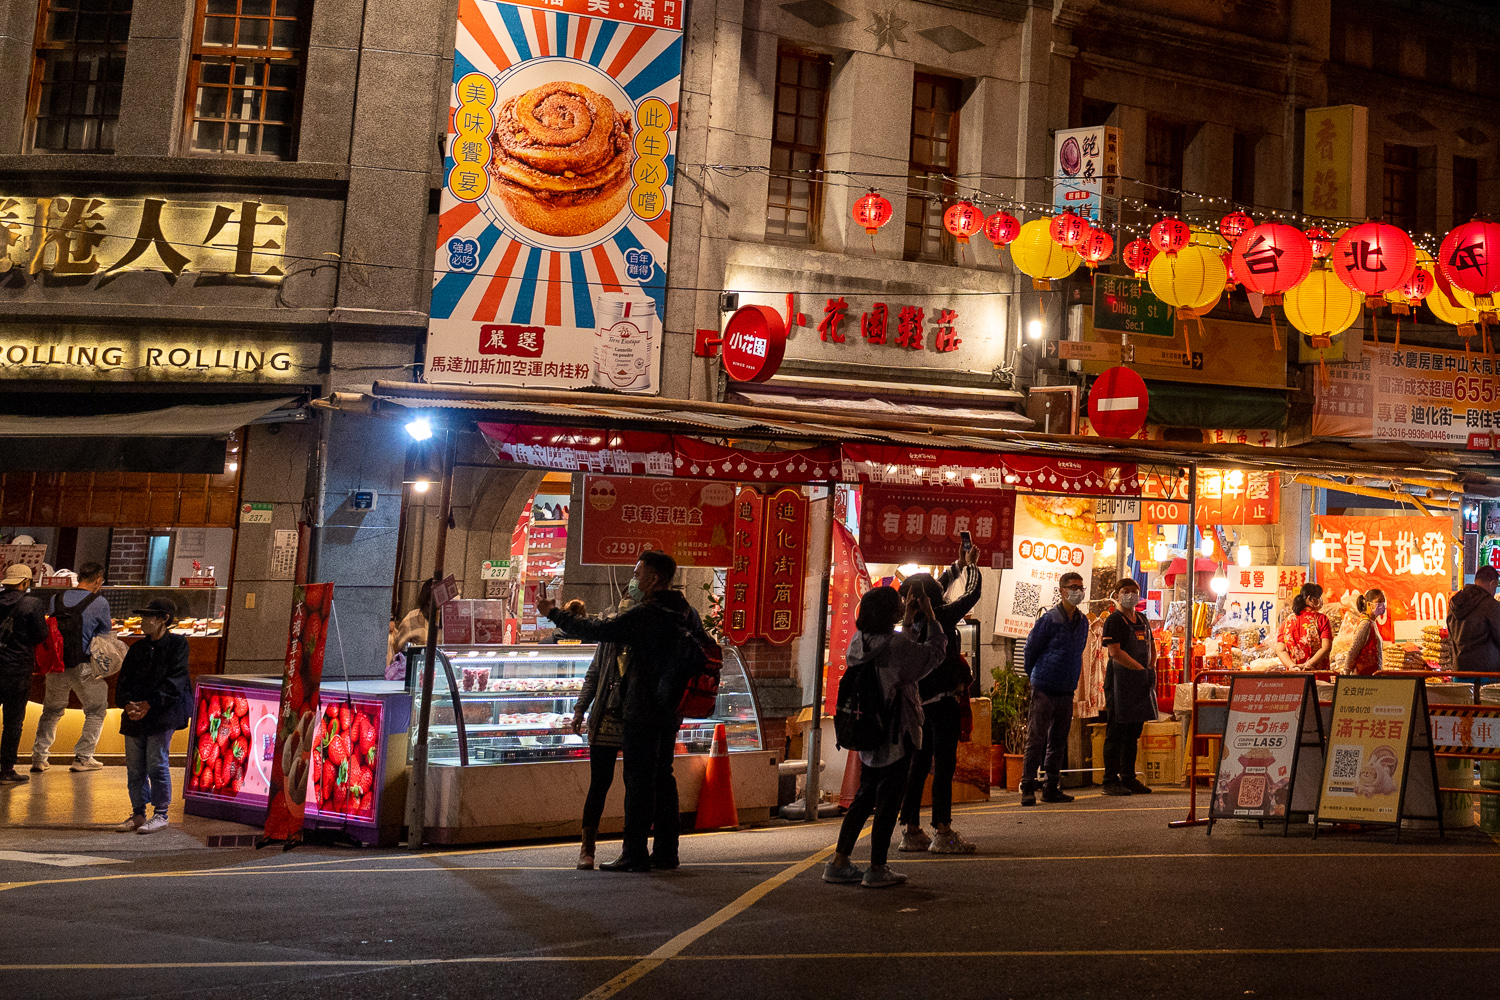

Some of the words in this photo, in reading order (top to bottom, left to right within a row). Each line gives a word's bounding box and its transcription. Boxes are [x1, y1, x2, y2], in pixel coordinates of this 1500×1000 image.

[663, 0, 676, 27] 門市
[456, 81, 487, 194] 美味饗宴
[637, 107, 666, 213] 此生必嚐
[1082, 133, 1100, 185] 鮑魚
[453, 242, 475, 255] 強身
[629, 252, 650, 264] 百年
[1243, 234, 1284, 275] 台
[1344, 239, 1387, 273] 北
[1449, 236, 1490, 277] 年
[451, 254, 474, 267] 必吃
[629, 263, 649, 276] 難得
[1103, 279, 1154, 299] 迪化街一
[1112, 301, 1137, 316] DiHua
[1147, 304, 1159, 318] St.
[1125, 318, 1144, 331] Sec.1
[484, 329, 541, 351] 嚴選
[729, 331, 768, 358] 小花園
[0, 344, 122, 367] OLLING
[146, 347, 291, 371] ROLLING
[429, 356, 590, 380] 馬達加斯加空運肉桂粉
[1377, 402, 1408, 424] 專營
[249, 514, 263, 522] 237
[621, 504, 703, 526] 草莓蛋糕盒
[1322, 530, 1447, 576] 年貨大批發
[490, 569, 507, 578] 237
[731, 502, 754, 630] 迪化街商圈
[773, 502, 798, 630] 迪化街商圈
[1240, 570, 1265, 588] 專營
[488, 587, 507, 596] 237
[1342, 686, 1365, 696] 全支付
[1339, 705, 1371, 714] 01/06-01/20
[1235, 717, 1290, 734] 新戶5折券
[1336, 718, 1404, 740] 滿千送百
[1253, 737, 1284, 747] LAS5
